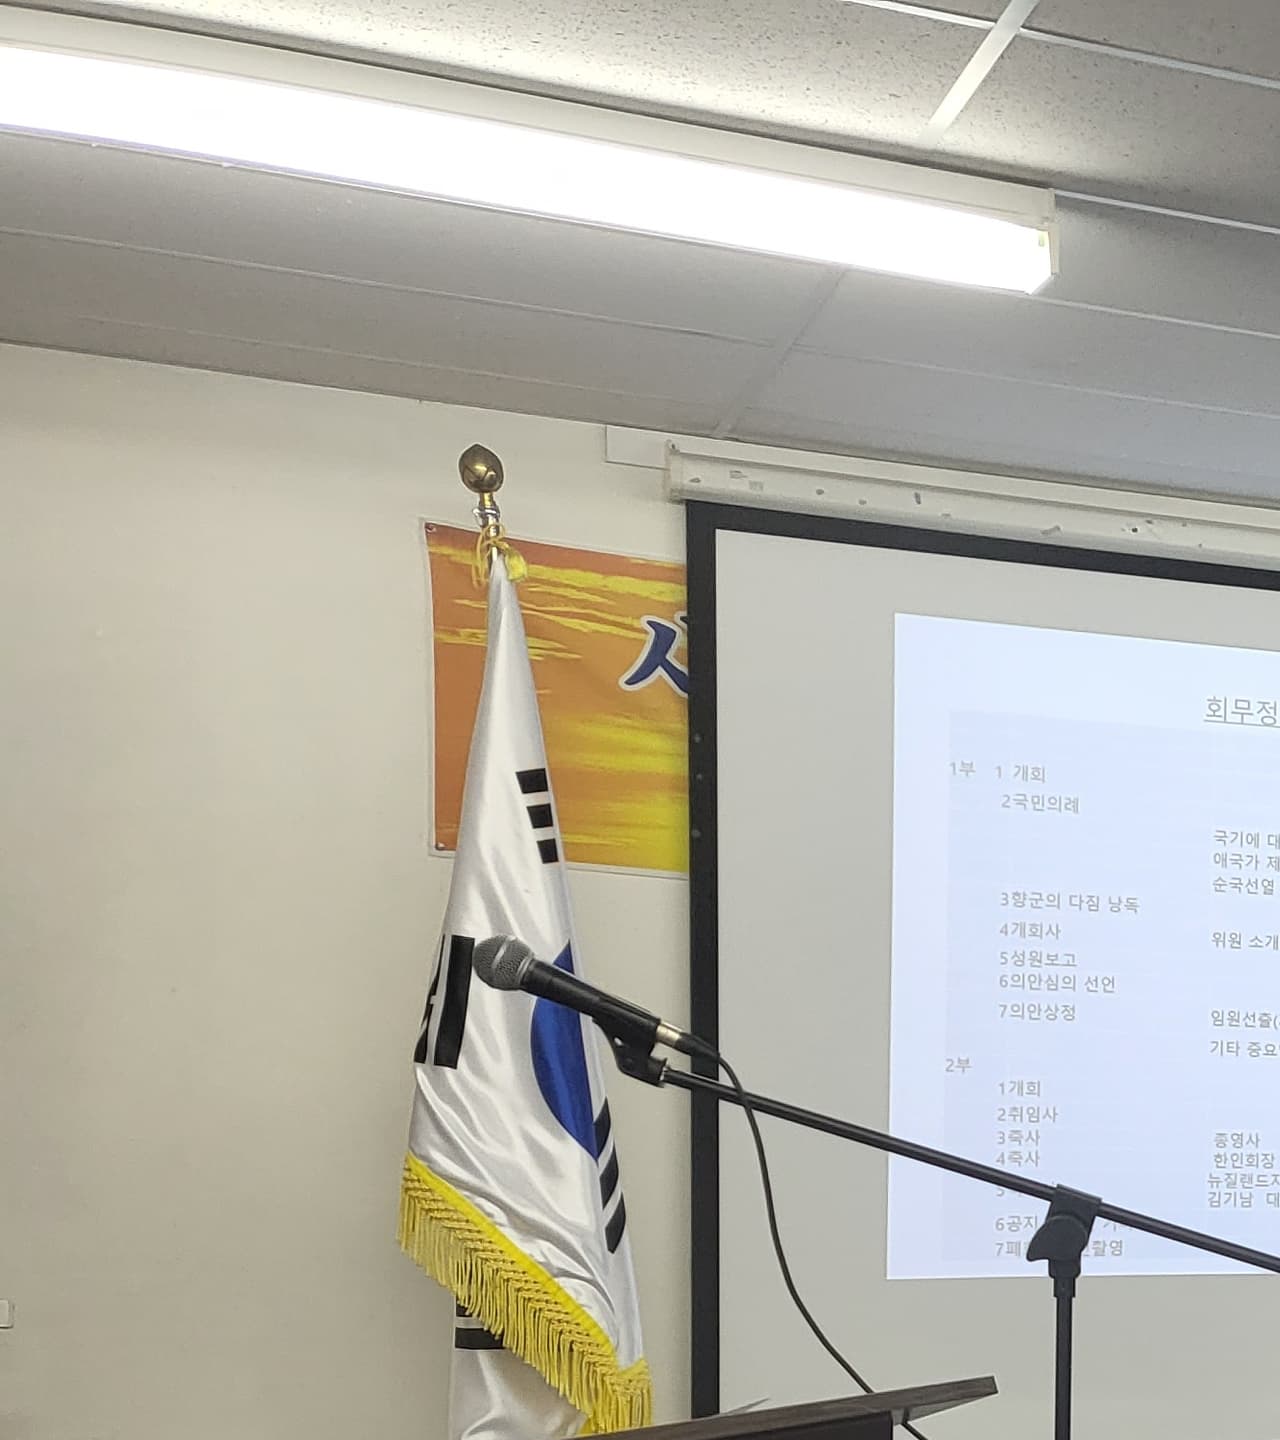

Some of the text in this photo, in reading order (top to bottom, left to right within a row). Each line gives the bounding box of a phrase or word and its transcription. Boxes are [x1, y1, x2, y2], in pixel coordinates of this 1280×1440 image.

[949, 760, 977, 777] 1부
[1013, 764, 1047, 784] 개회
[1001, 793, 1081, 815] 2국민의례
[1212, 829, 1260, 849] 국기에
[1212, 851, 1260, 871] 애국가
[1212, 876, 1275, 896] 순국선열
[1000, 891, 1142, 915] 3향군의 다짐 낭독
[999, 921, 1062, 941] 4개회사
[1211, 931, 1243, 949] 위원
[1248, 933, 1280, 951] 소개
[999, 950, 1079, 969] 5성원보고
[999, 973, 1117, 994] 6의안심의 선언
[998, 1004, 1077, 1022] 7의안상정
[1208, 1040, 1241, 1057] 기타
[945, 1057, 974, 1075] 2부
[998, 1080, 1042, 1098] 1개회
[997, 1106, 1059, 1124] 2취임사
[996, 1129, 1041, 1147] 3축사
[1213, 1152, 1276, 1170] 한인회장
[1207, 1191, 1254, 1209] 김기남
[995, 1240, 1028, 1258] 7폐
